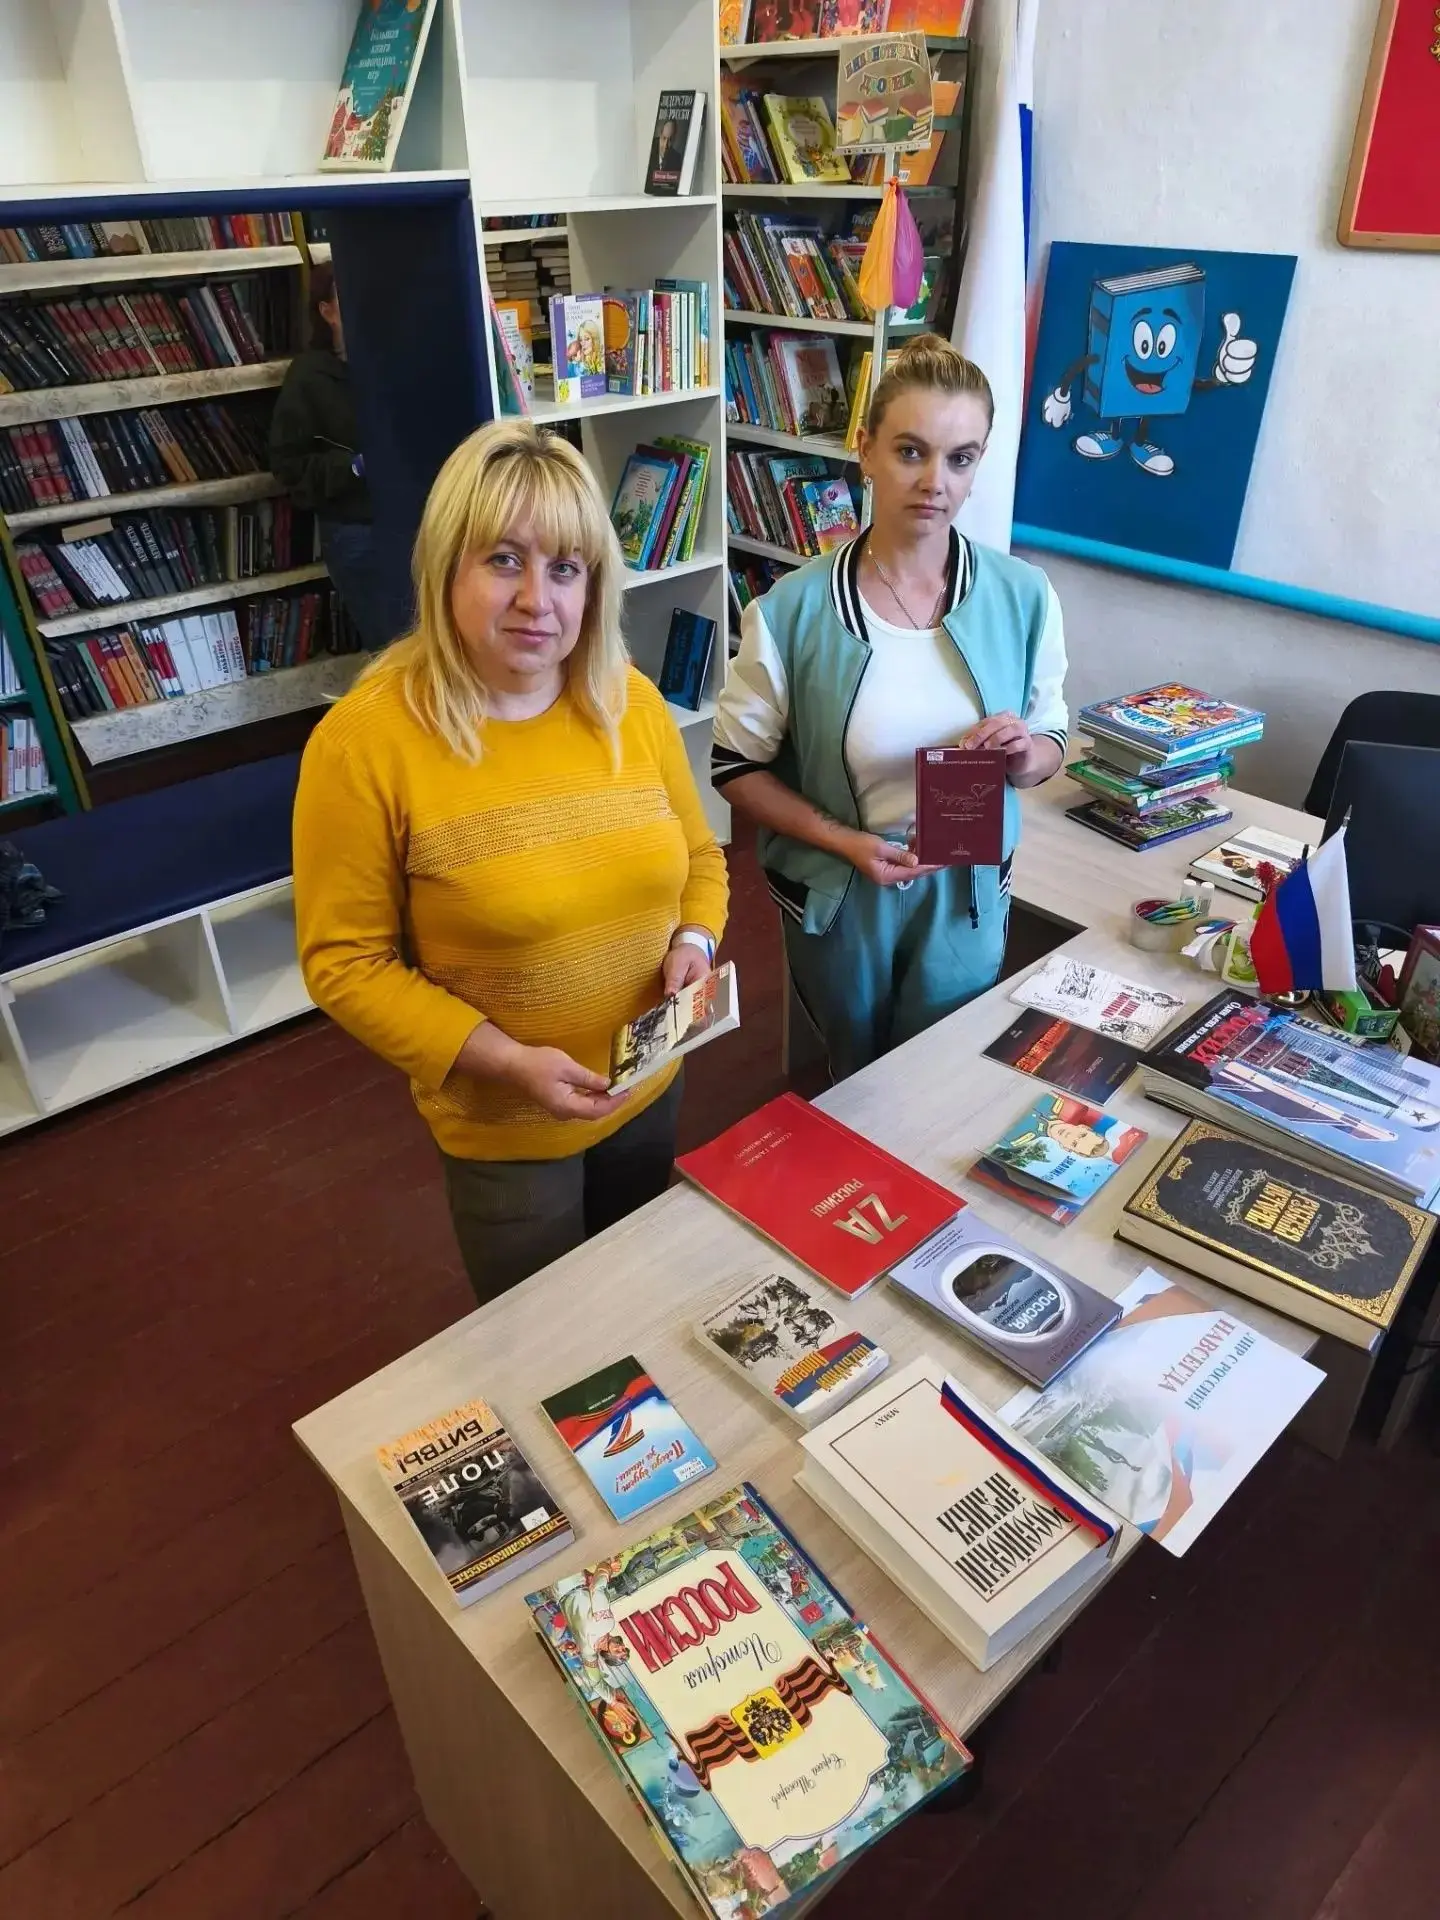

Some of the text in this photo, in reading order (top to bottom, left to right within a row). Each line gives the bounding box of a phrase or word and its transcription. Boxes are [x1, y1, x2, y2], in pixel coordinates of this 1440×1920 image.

[1199, 1011, 1225, 1030] день
[1213, 997, 1242, 1019] Один
[807, 1177, 866, 1218] РОССИЮ!
[829, 1191, 911, 1251] ZA
[1242, 1181, 1294, 1230] ИСТОРИЯ
[1270, 1192, 1322, 1243] РУССКАЯ
[1007, 1288, 1059, 1334] РОССИЯ,
[1154, 1314, 1236, 1397] НАВСЕГДА
[1182, 1359, 1235, 1412] РОССИЕЙ
[871, 1406, 901, 1428] MMXV
[393, 1418, 485, 1474] БИТВЫ
[644, 1439, 688, 1473] Победа
[415, 1448, 506, 1507] ПОЛЕ
[615, 1463, 654, 1494] будет
[617, 1562, 762, 1674] РОССИИ
[673, 1617, 786, 1708] История
